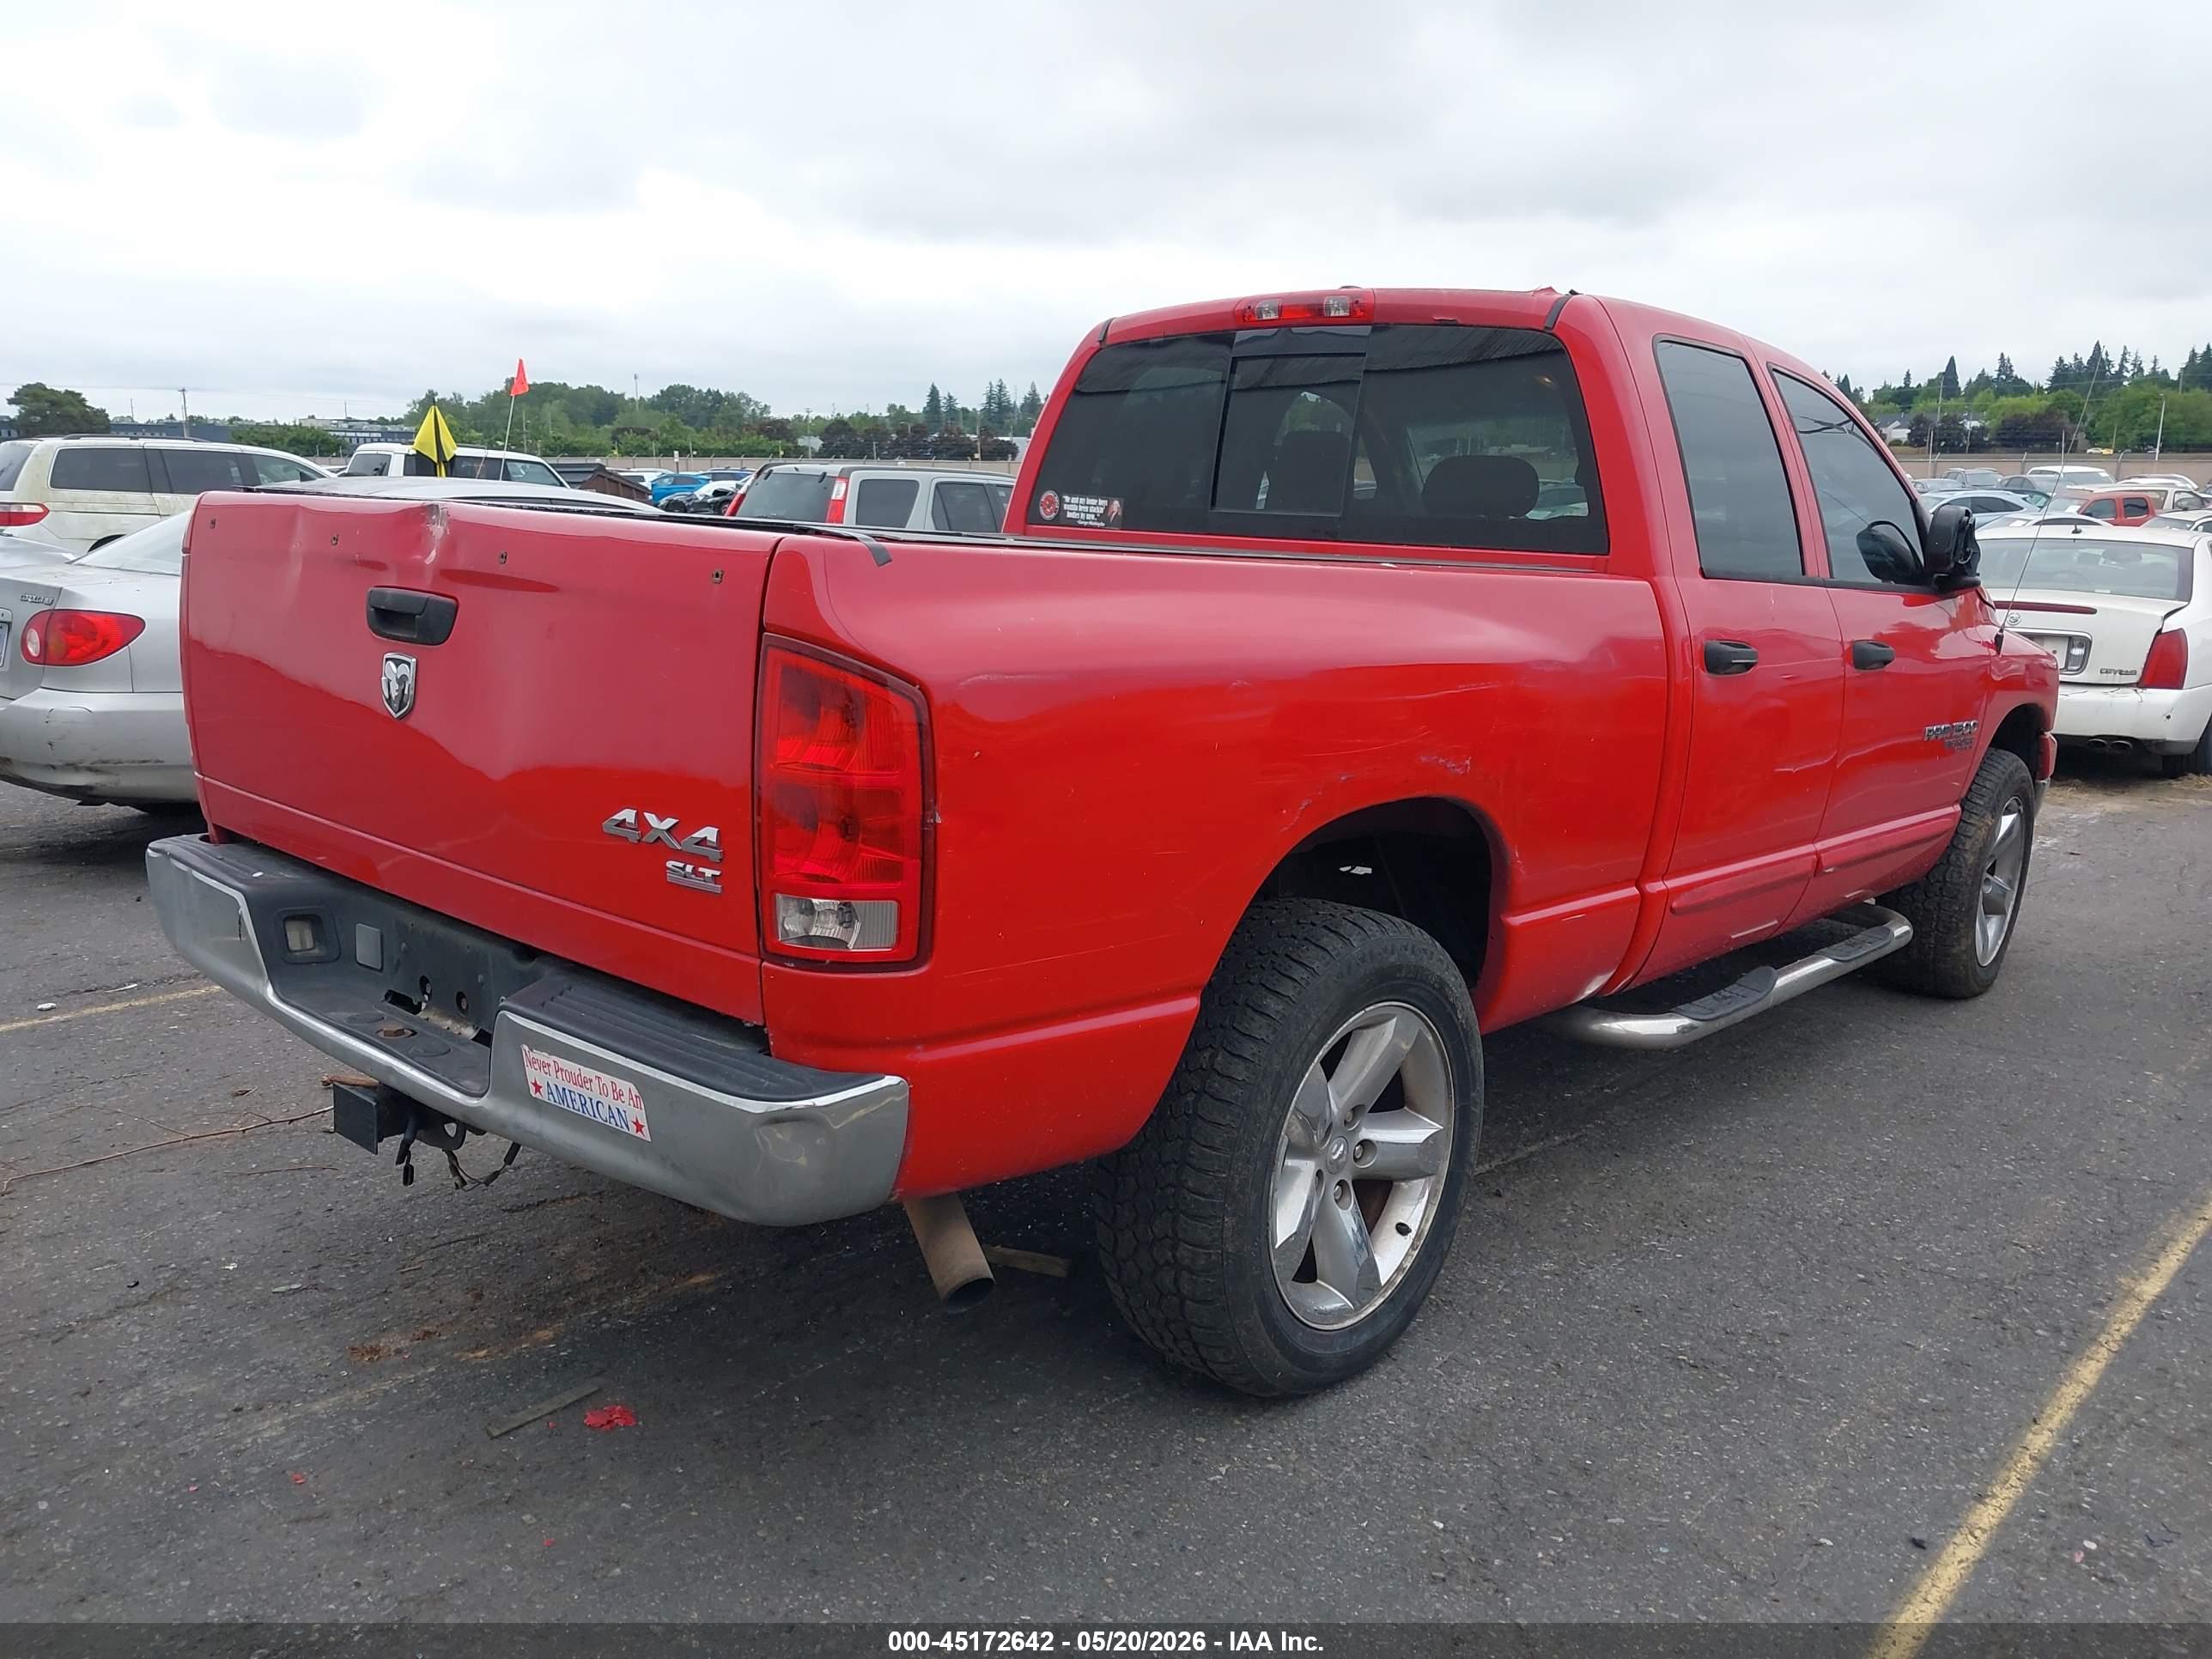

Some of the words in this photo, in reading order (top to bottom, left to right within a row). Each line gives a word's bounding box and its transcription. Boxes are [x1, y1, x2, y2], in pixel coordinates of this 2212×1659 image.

[665, 860, 722, 885] SLT
[524, 1049, 551, 1077] Never
[553, 1060, 592, 1092] Prouder
[595, 1075, 609, 1097] To
[611, 1081, 625, 1103] Be
[628, 1088, 643, 1110] An
[546, 1081, 630, 1132] AMERICAN
